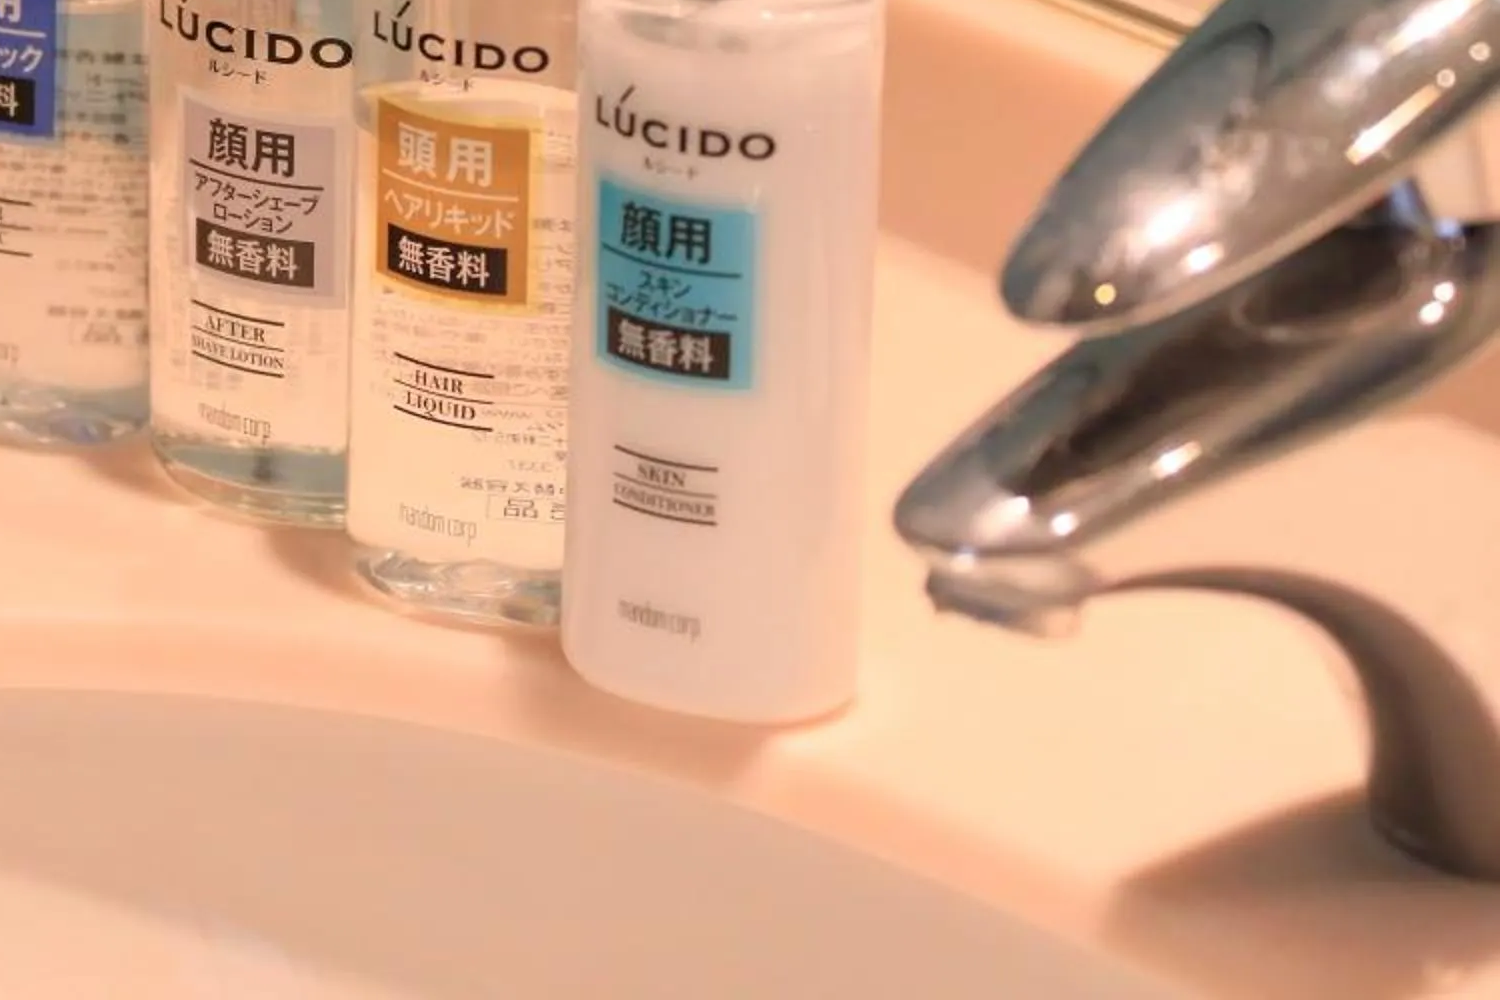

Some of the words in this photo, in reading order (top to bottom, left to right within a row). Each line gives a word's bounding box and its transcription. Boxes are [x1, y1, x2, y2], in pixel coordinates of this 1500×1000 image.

[207, 117, 295, 177] 顔用
[397, 121, 493, 187] 頭用
[194, 172, 320, 216] アフターシェーブ
[384, 188, 516, 238] ヘアリキッド
[213, 202, 293, 234] ローション
[621, 201, 712, 265] 顔用
[207, 229, 299, 280] 無香料
[398, 236, 490, 287] 無香料
[605, 281, 739, 327] コンディショナー
[639, 270, 693, 299] スキン
[204, 314, 266, 343] AFTER
[618, 319, 714, 373] 無香料
[229, 346, 284, 369] LOTION
[414, 369, 464, 395] HAIR
[405, 391, 476, 422] LIQUID
[636, 463, 687, 487] SKIN
